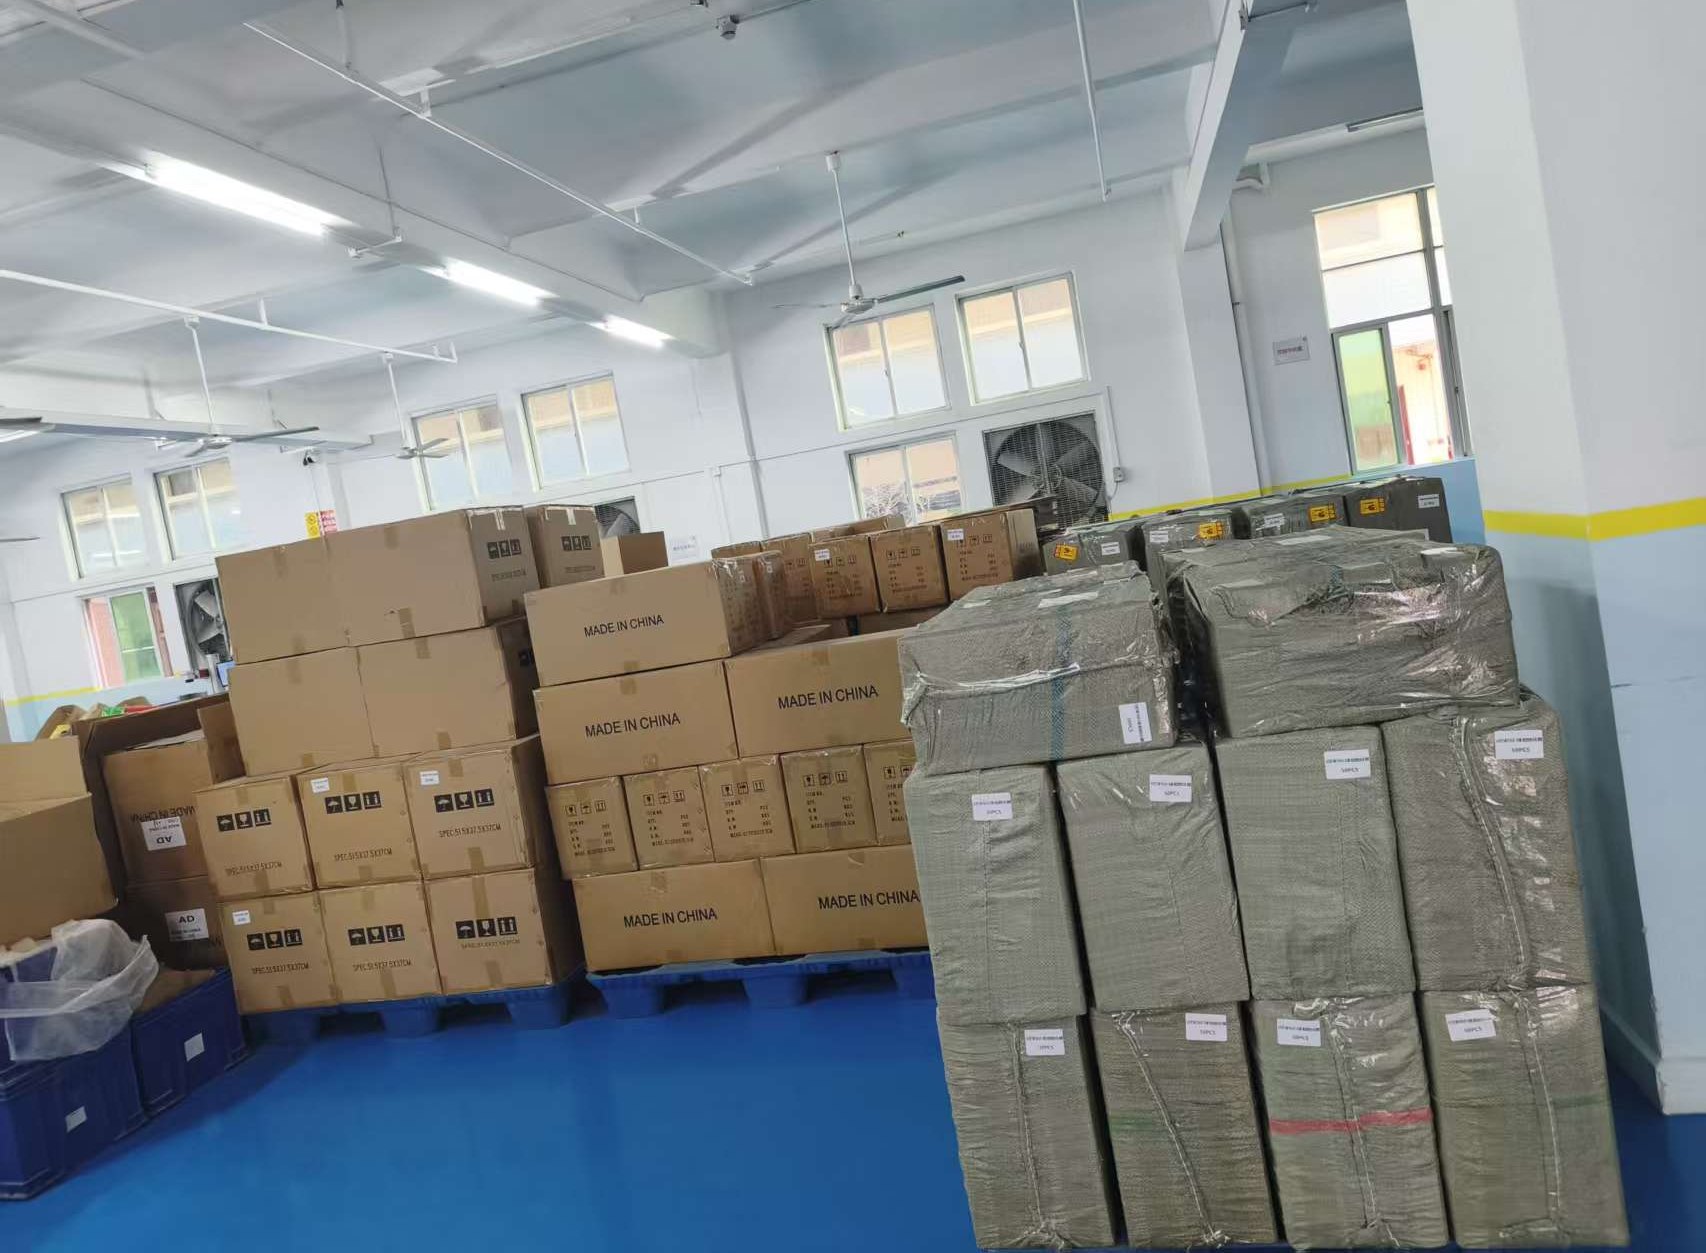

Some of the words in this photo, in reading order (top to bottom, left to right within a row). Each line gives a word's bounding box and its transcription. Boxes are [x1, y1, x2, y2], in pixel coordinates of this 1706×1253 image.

[584, 622, 615, 637] MADE
[617, 620, 628, 632] IN
[629, 614, 664, 630] CHINA
[778, 692, 816, 709] MADE
[819, 690, 833, 704] IN
[835, 684, 879, 701] CHINA
[585, 720, 622, 738] MADE
[624, 719, 637, 733] IN
[640, 712, 681, 730] CHINA
[156, 836, 172, 844] AD
[818, 894, 857, 910] MADE
[860, 893, 874, 906] IN
[876, 889, 920, 905] CHINA
[179, 915, 195, 924] AD
[624, 913, 659, 928] MADE
[661, 912, 675, 925] IN
[677, 908, 718, 923] CHINA
